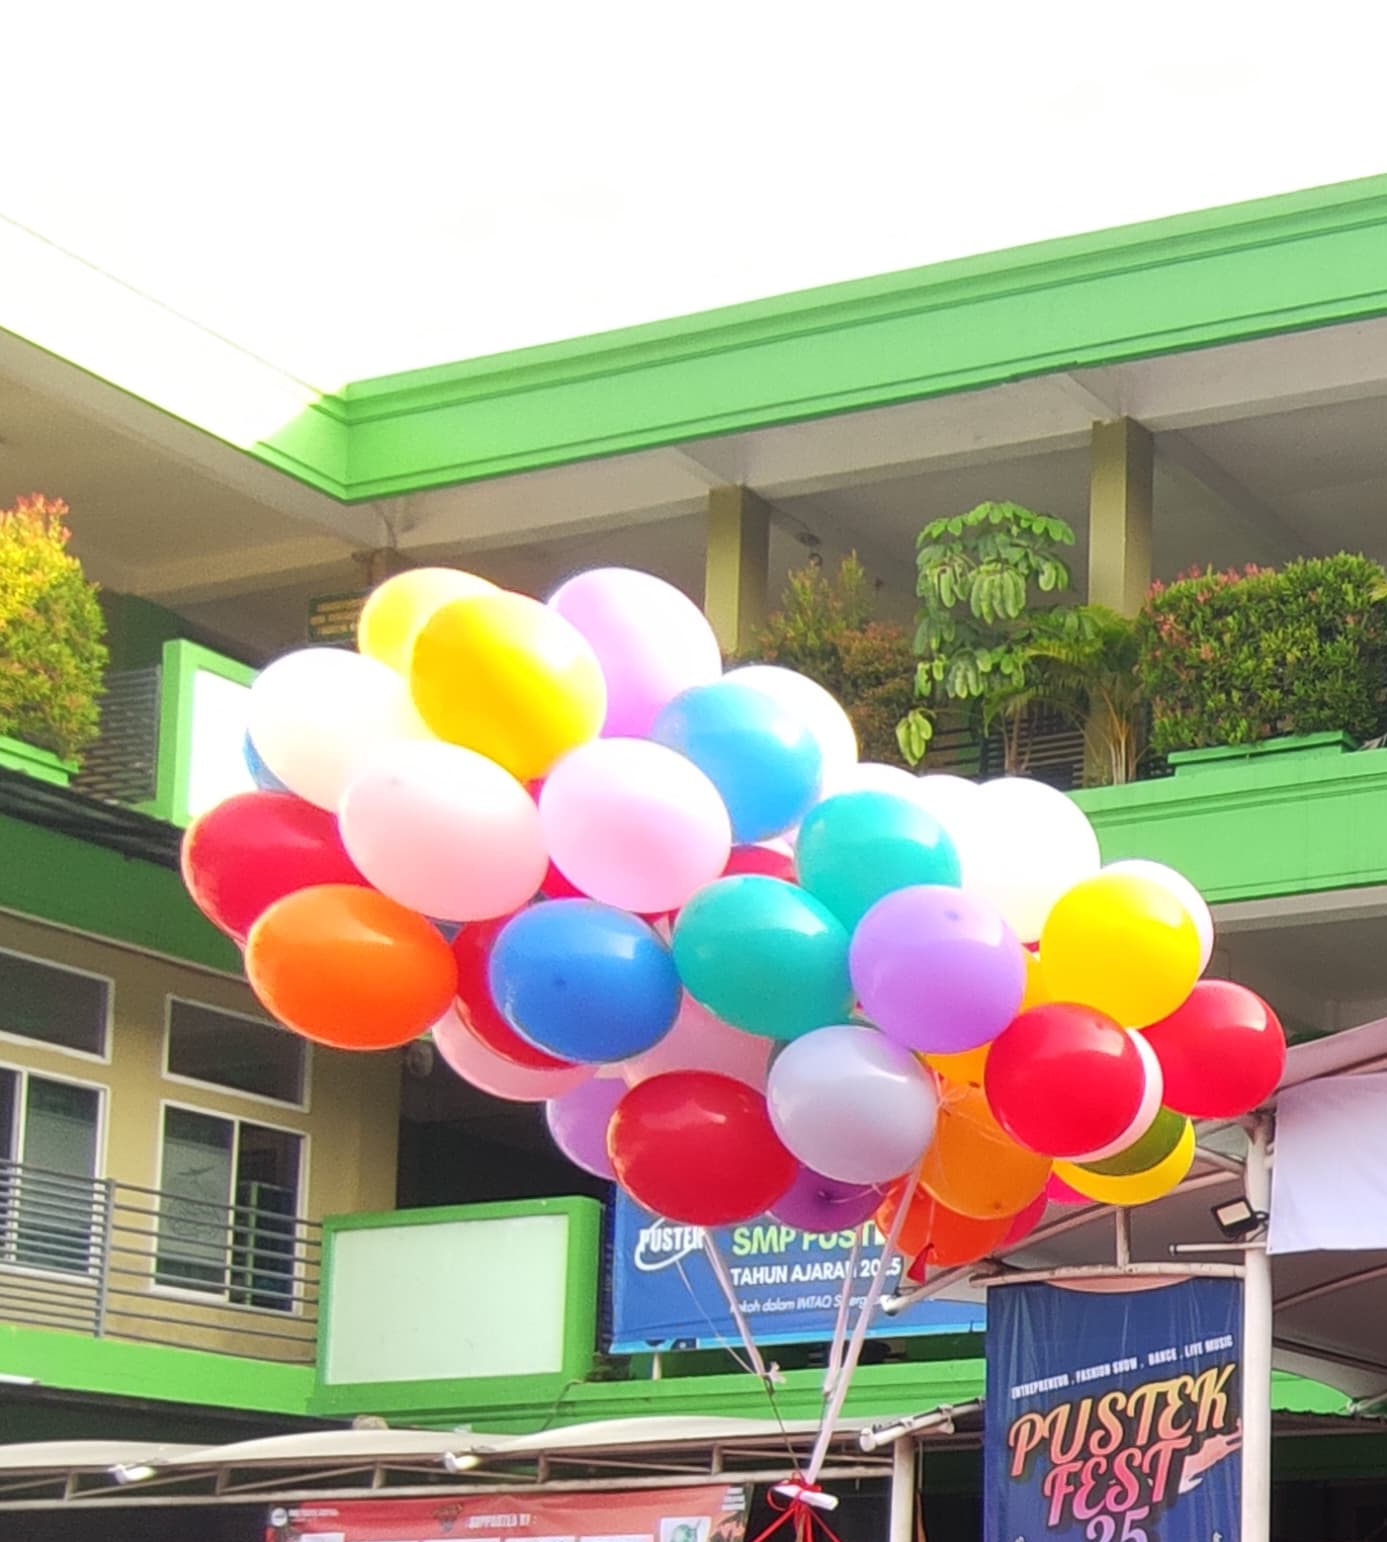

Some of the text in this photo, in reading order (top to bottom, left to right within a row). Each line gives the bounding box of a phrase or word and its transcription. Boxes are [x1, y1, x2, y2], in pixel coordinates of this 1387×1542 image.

[732, 1226, 796, 1257] SMP
[730, 1264, 787, 1286] TAHUN
[762, 1298, 795, 1313] dalam
[1111, 1356, 1138, 1375] SHOW
[1008, 1363, 1236, 1477] PUSTEK
[1043, 1435, 1192, 1527] FEST
